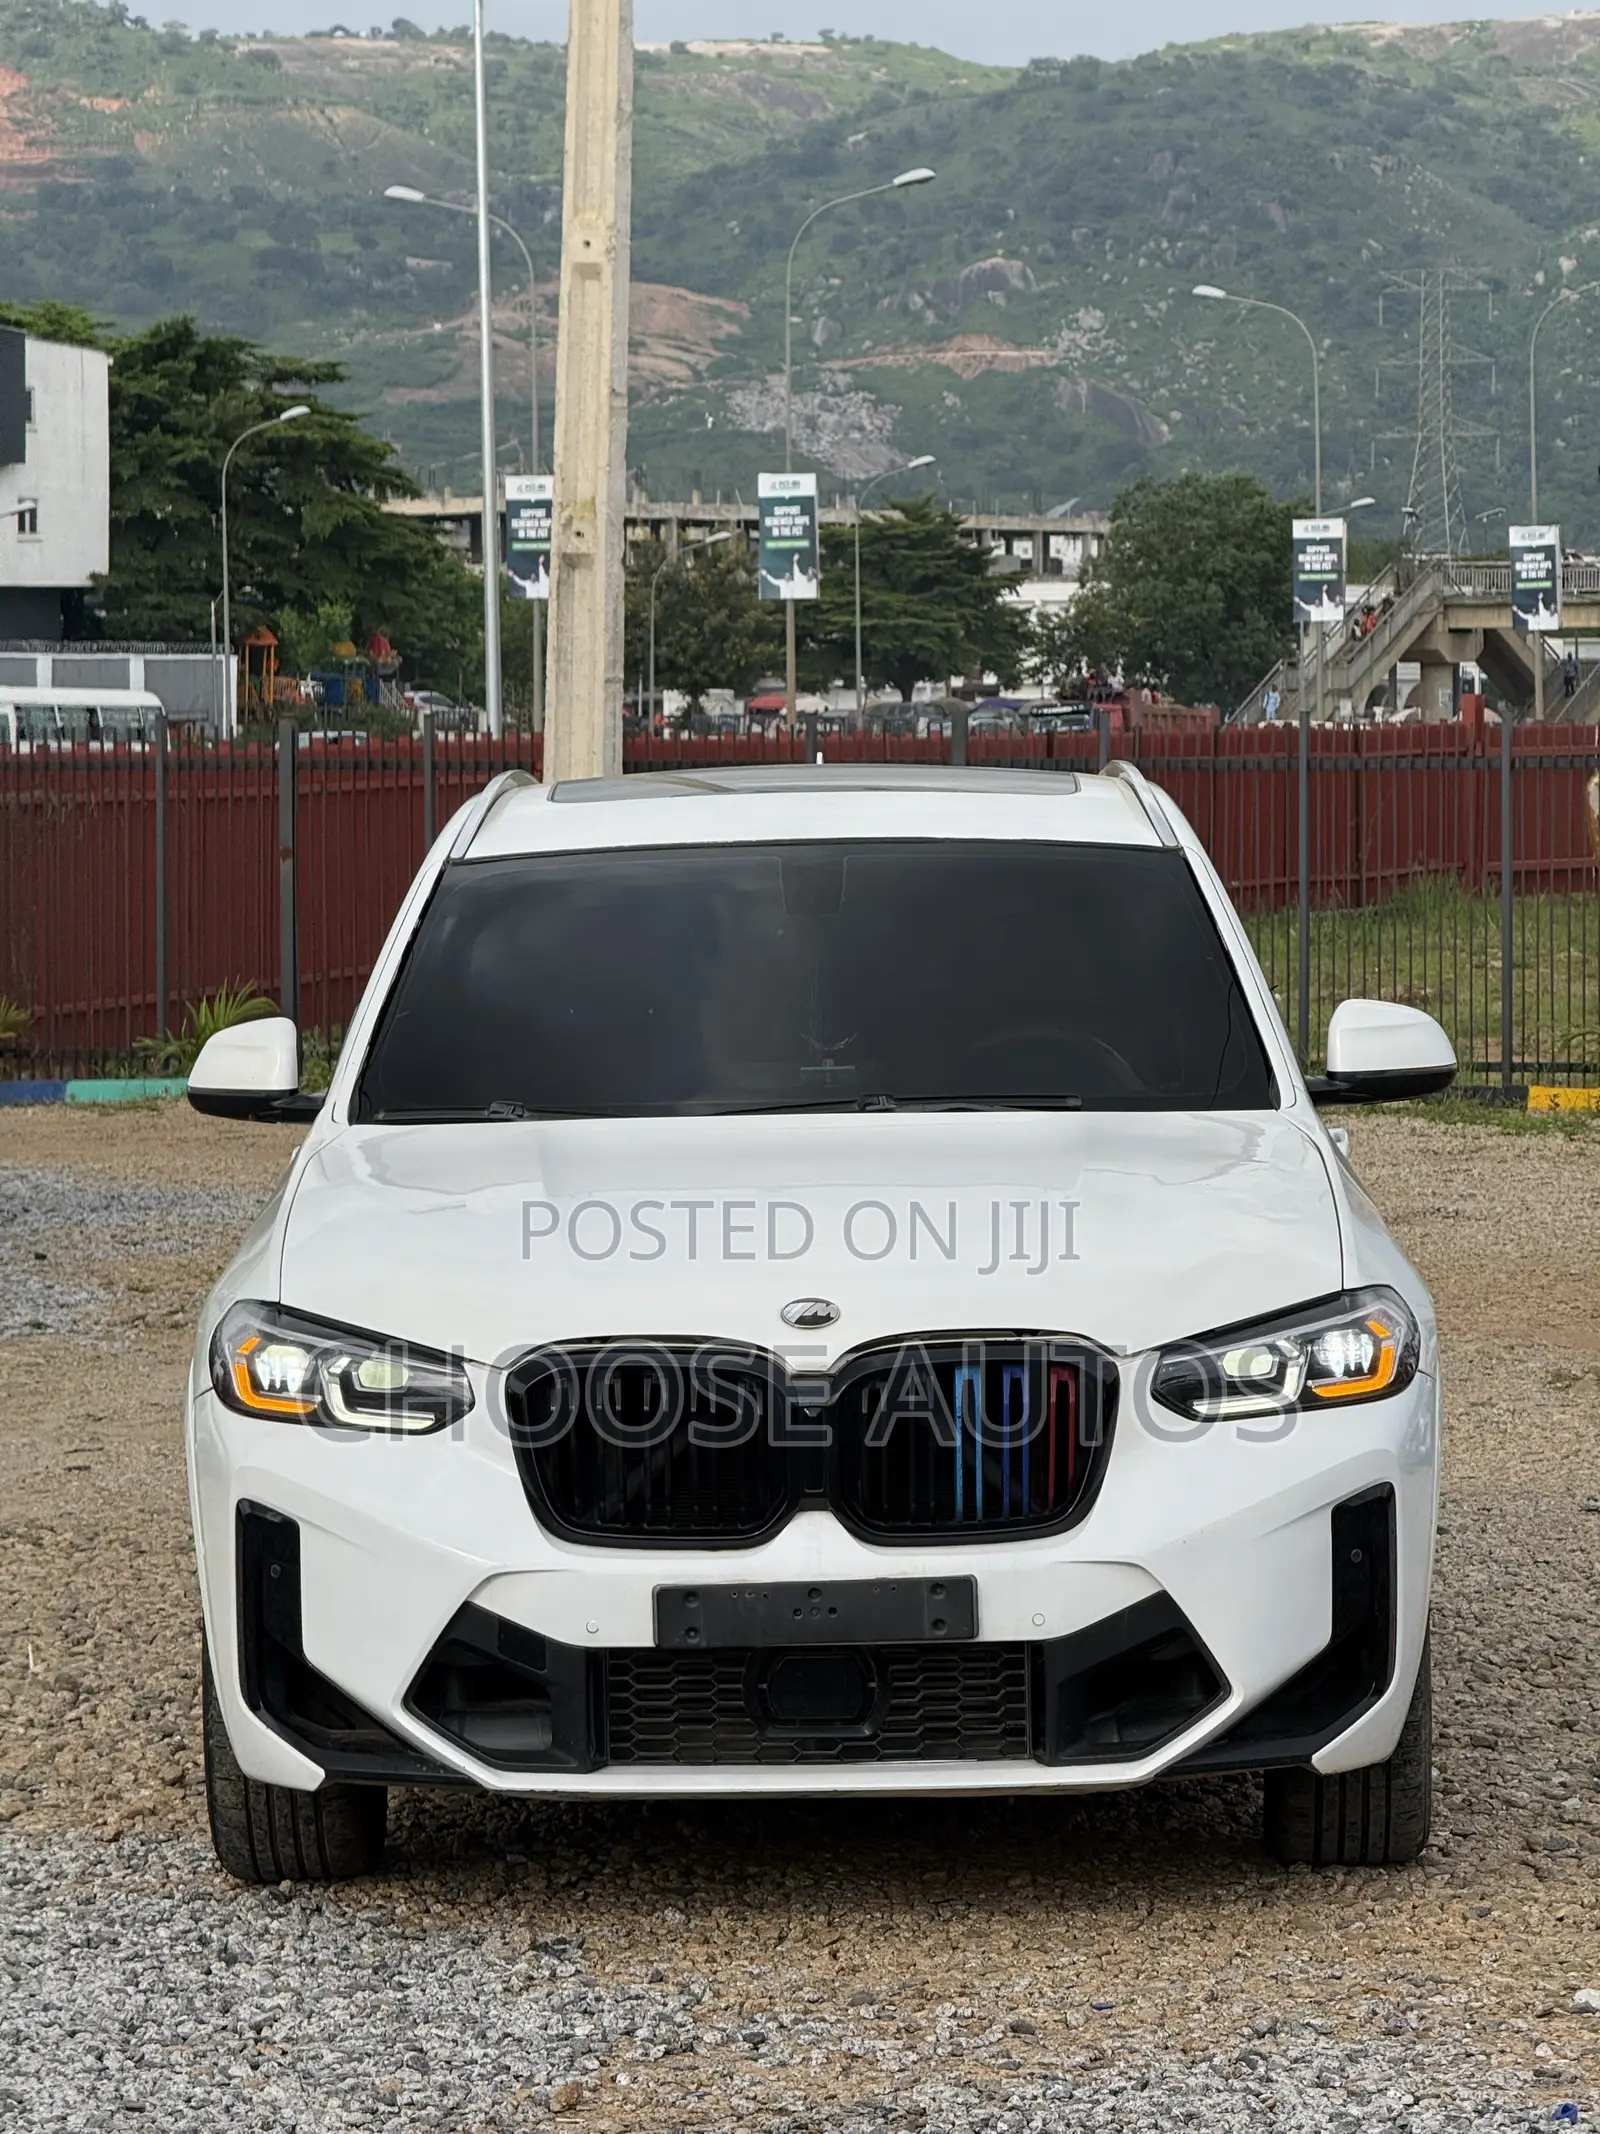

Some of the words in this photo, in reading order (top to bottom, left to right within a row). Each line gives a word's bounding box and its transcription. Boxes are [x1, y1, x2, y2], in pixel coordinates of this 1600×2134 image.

[520, 508, 546, 518] SUPPORT
[774, 505, 801, 516] SUPPORT
[765, 516, 793, 527] RENEWED
